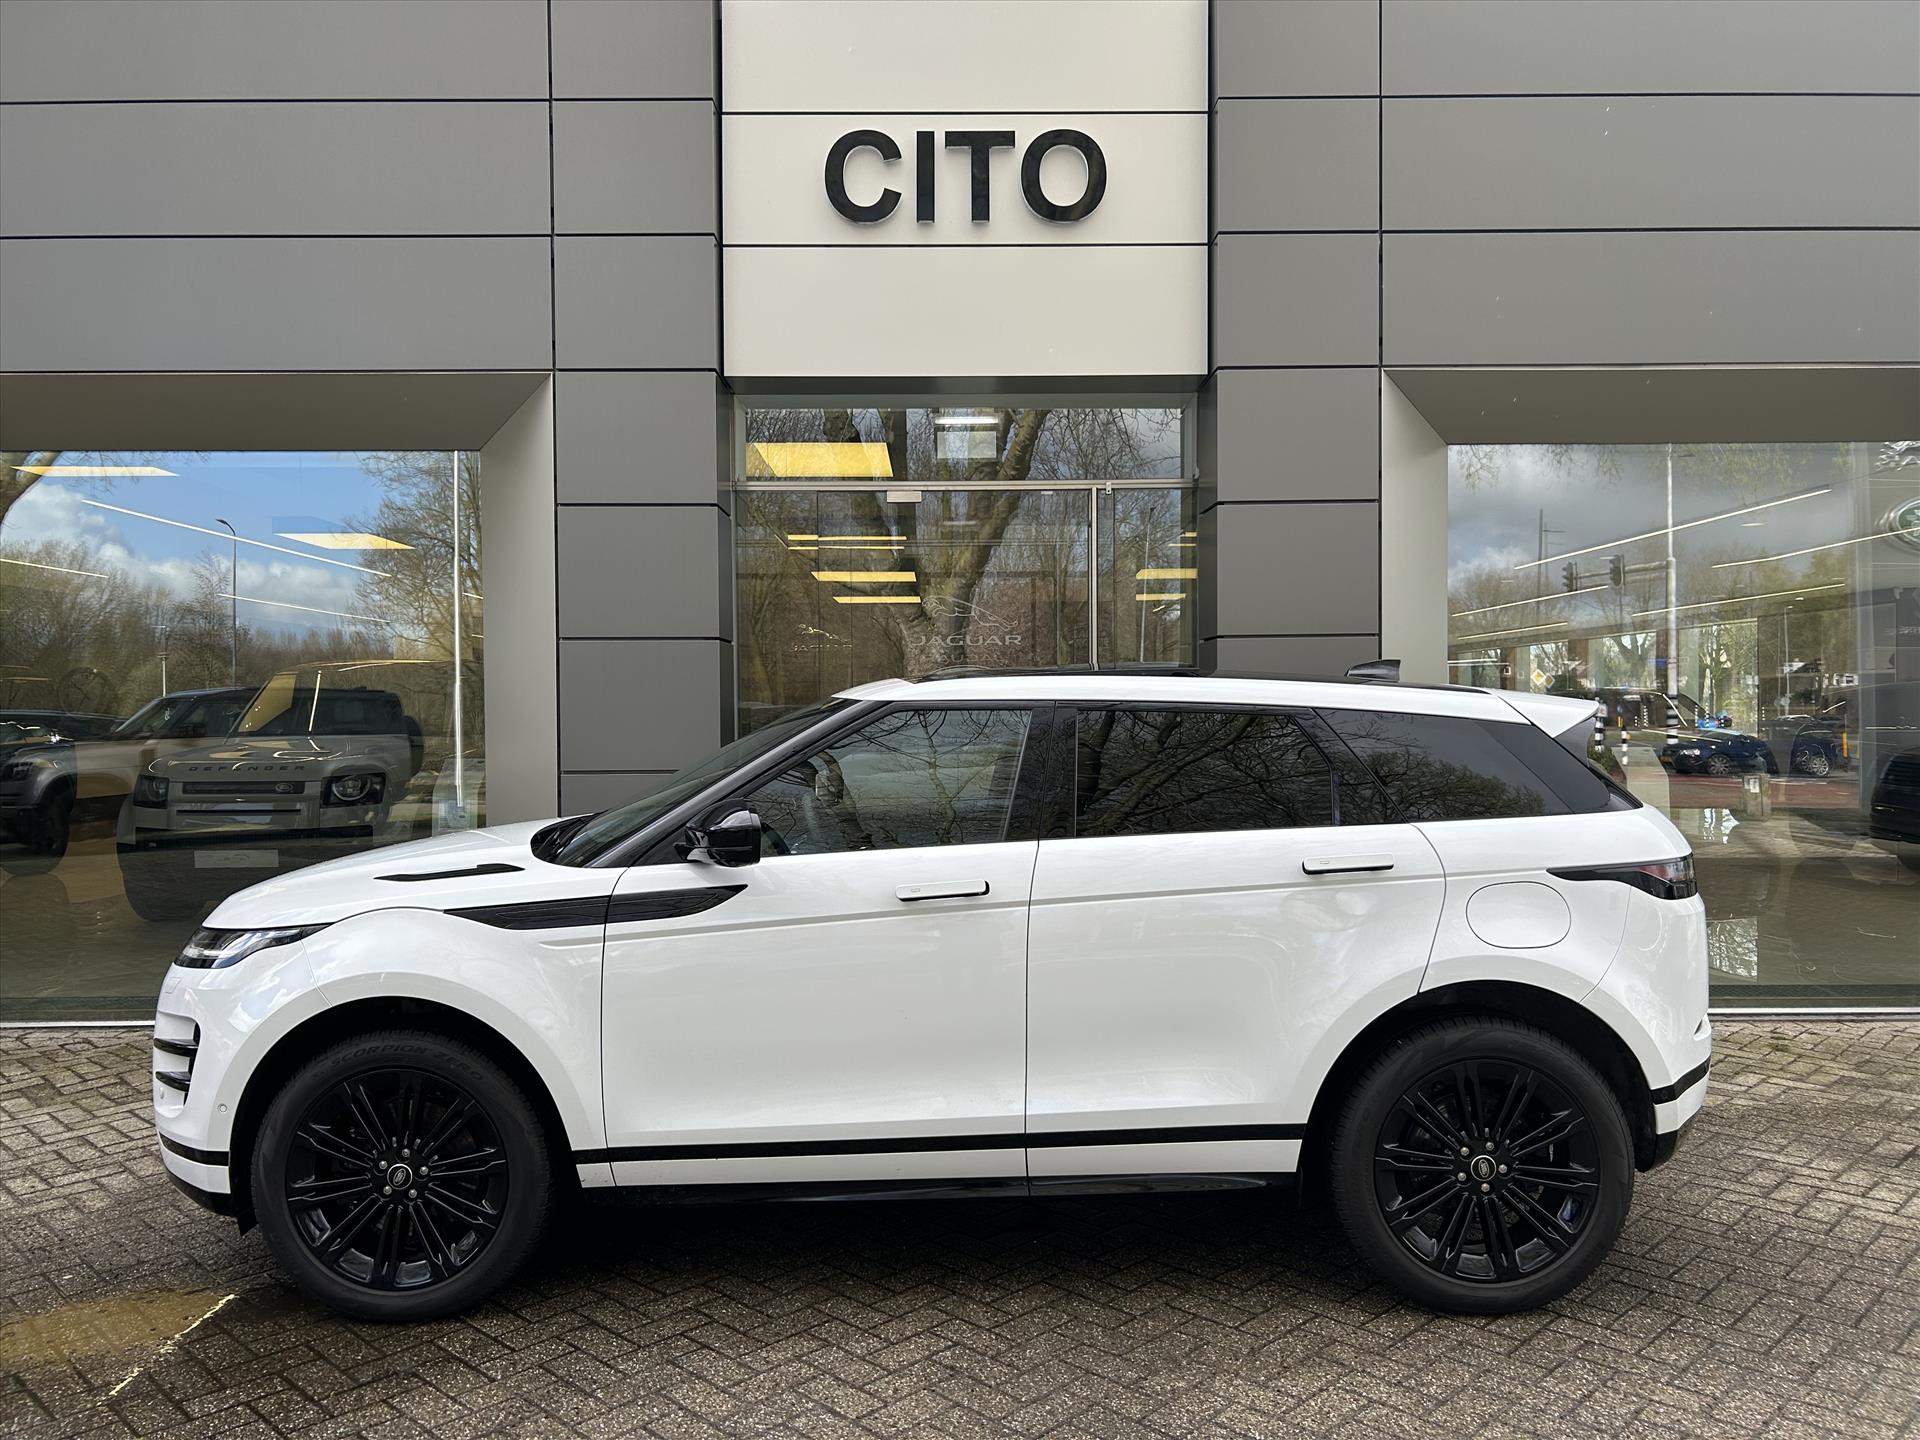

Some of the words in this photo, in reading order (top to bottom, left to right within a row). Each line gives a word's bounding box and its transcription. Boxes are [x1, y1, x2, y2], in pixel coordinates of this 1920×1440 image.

[824, 129, 1107, 223] CITO
[912, 635, 1021, 646] JAGUAR
[331, 1044, 429, 1066] SCORPION
[434, 1051, 483, 1081] ZERO
